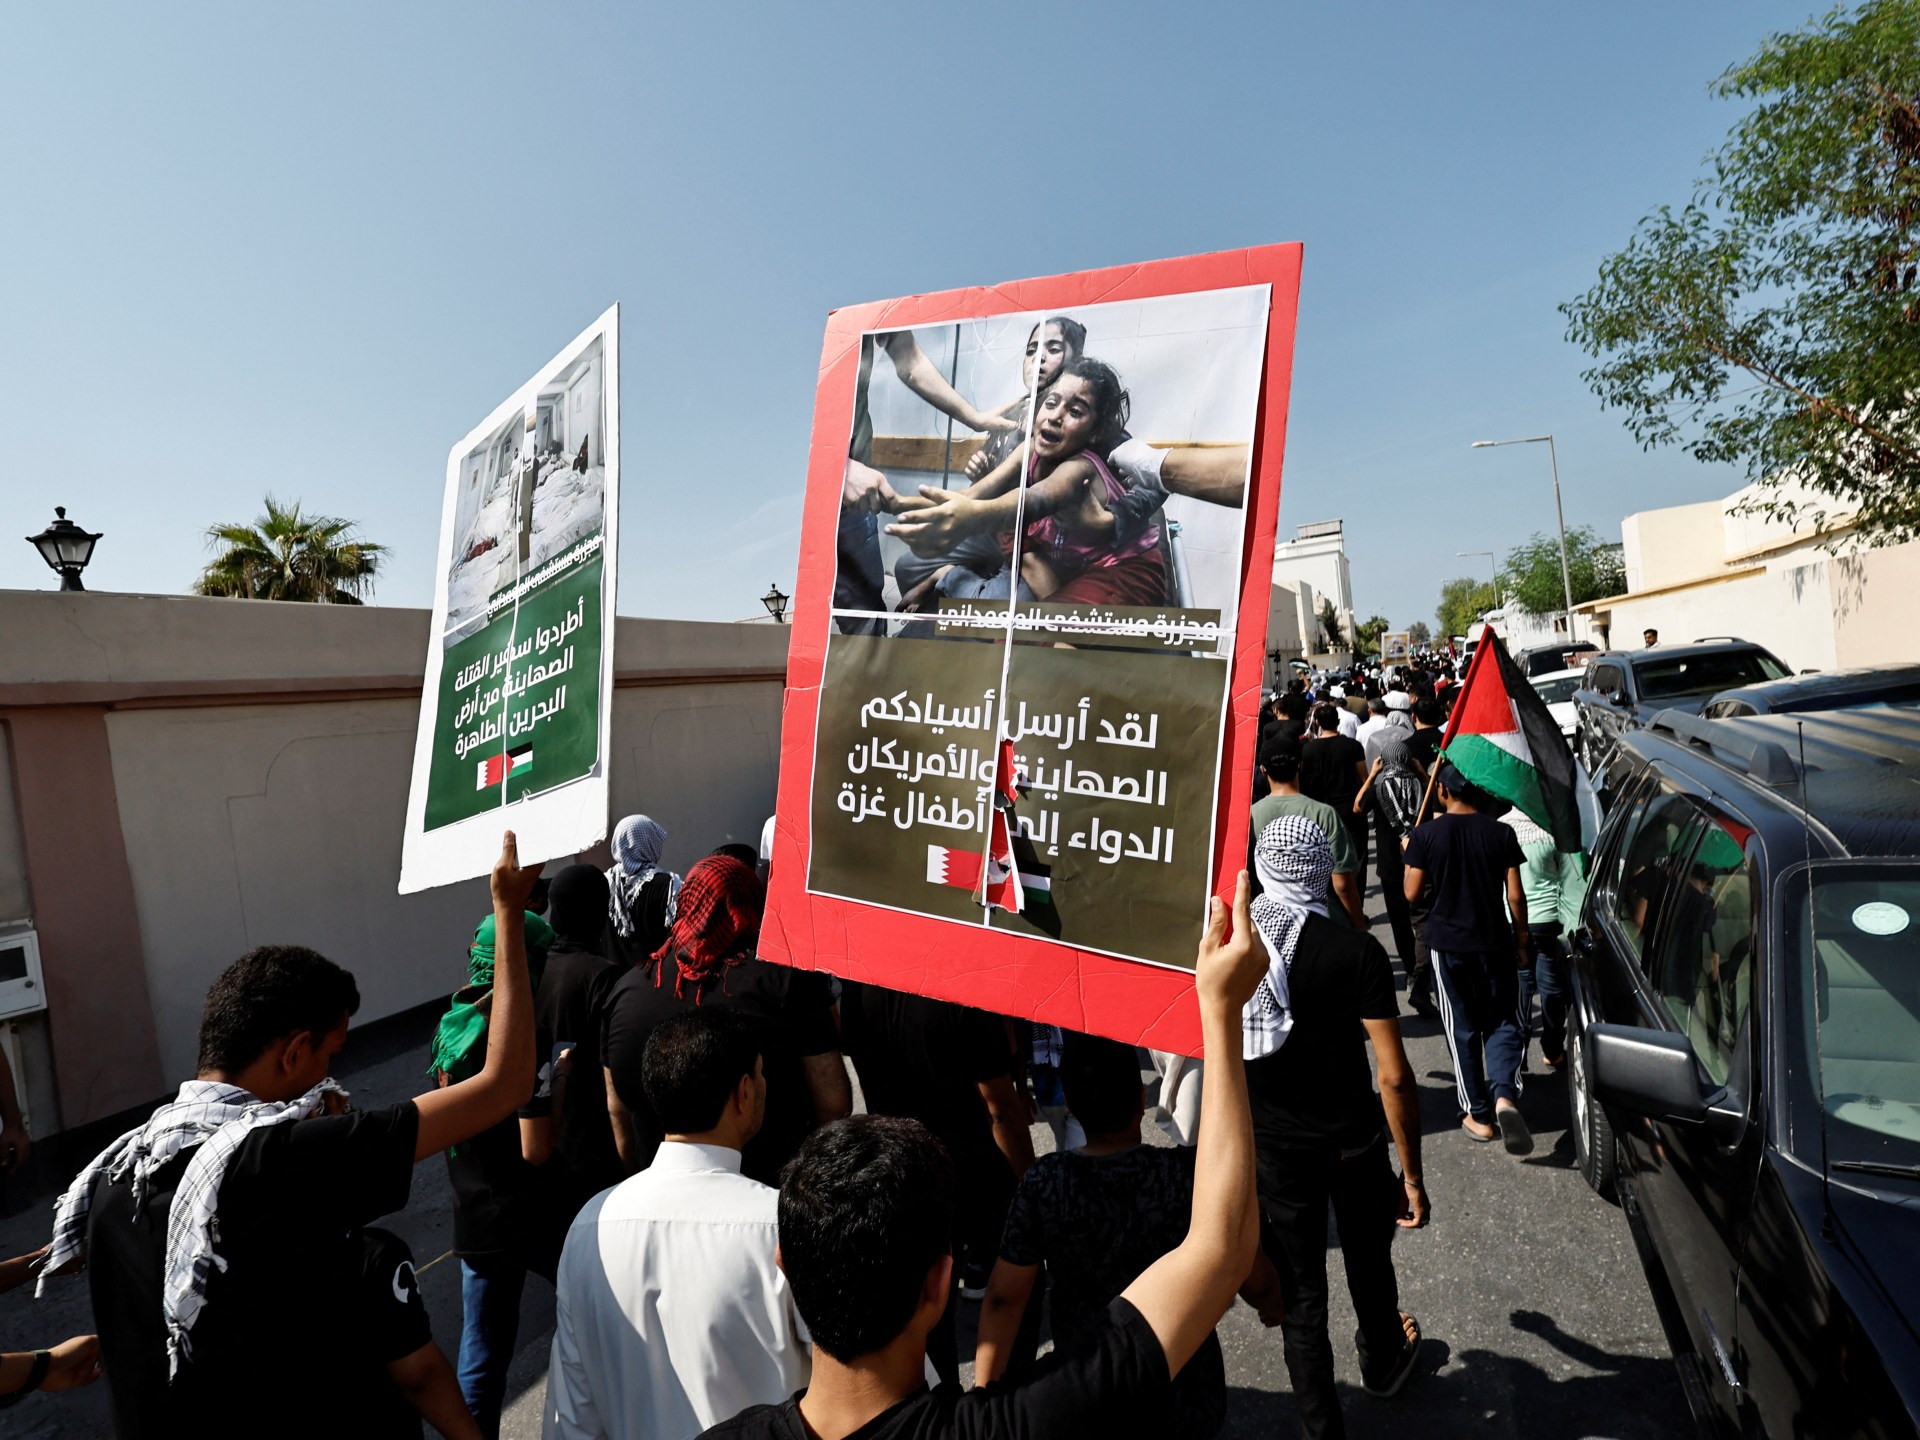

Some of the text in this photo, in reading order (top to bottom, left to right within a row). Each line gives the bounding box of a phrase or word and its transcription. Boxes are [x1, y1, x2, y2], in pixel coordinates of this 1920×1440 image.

[454, 595, 584, 692] أطردوا سفير القتلة
[454, 645, 574, 729] الصهاينة من أرض
[455, 684, 566, 760] البحرين الطاهرة
[861, 689, 1158, 750] لقد أرسل أسيادكم
[847, 737, 996, 793] والأمريكان
[837, 782, 887, 823] غزة
[893, 790, 987, 833] أطفال
[1068, 817, 1174, 864] الدواء
